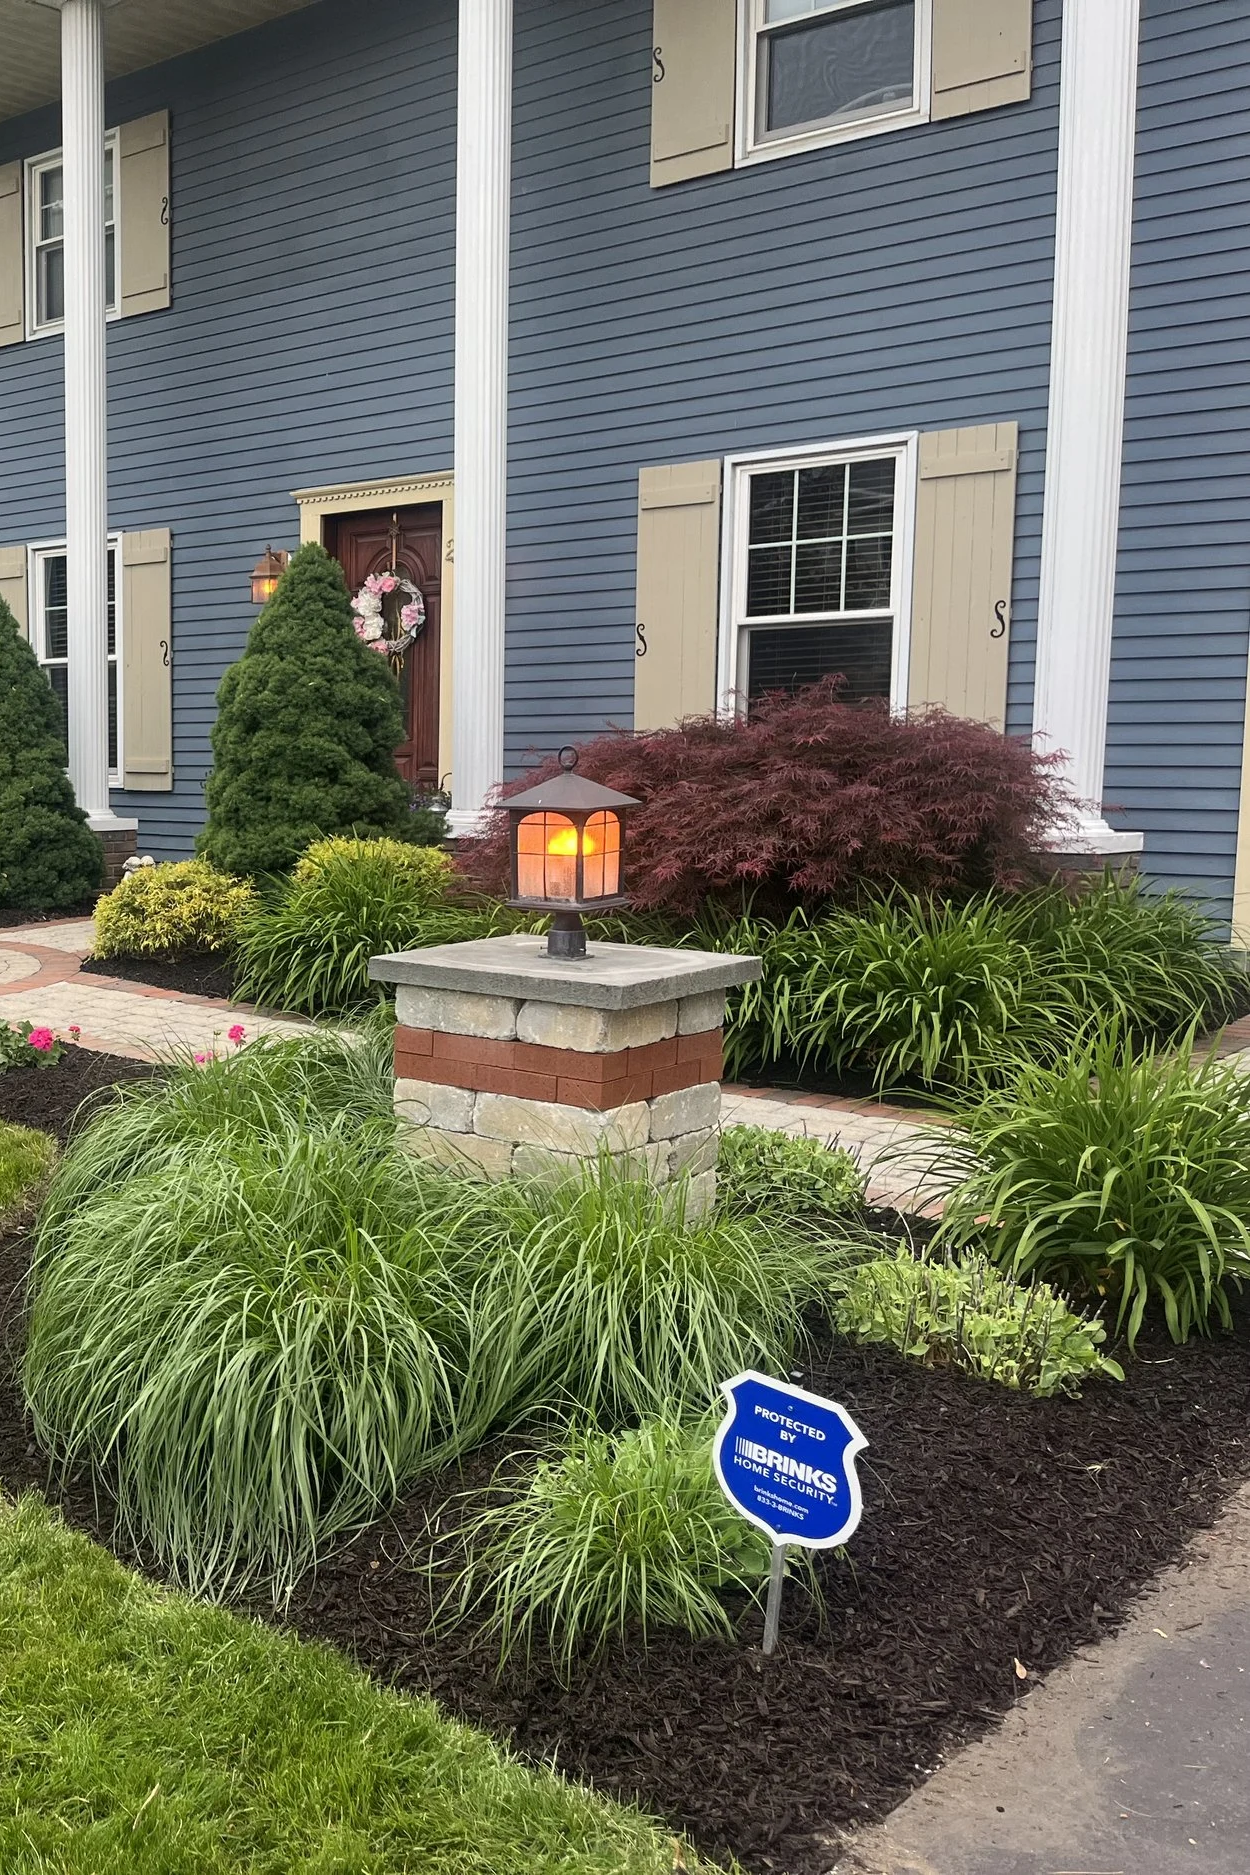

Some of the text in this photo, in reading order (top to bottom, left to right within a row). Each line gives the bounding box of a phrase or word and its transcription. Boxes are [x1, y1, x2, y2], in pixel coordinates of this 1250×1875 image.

[754, 1405, 826, 1441] PROTECTED
[779, 1429, 797, 1444] BY
[733, 1455, 835, 1505] HOME SECURITY
[751, 1440, 838, 1494] BRINKS
[753, 1484, 810, 1515] brinkshome.com
[756, 1494, 805, 1521] 833-3-BRINKS
